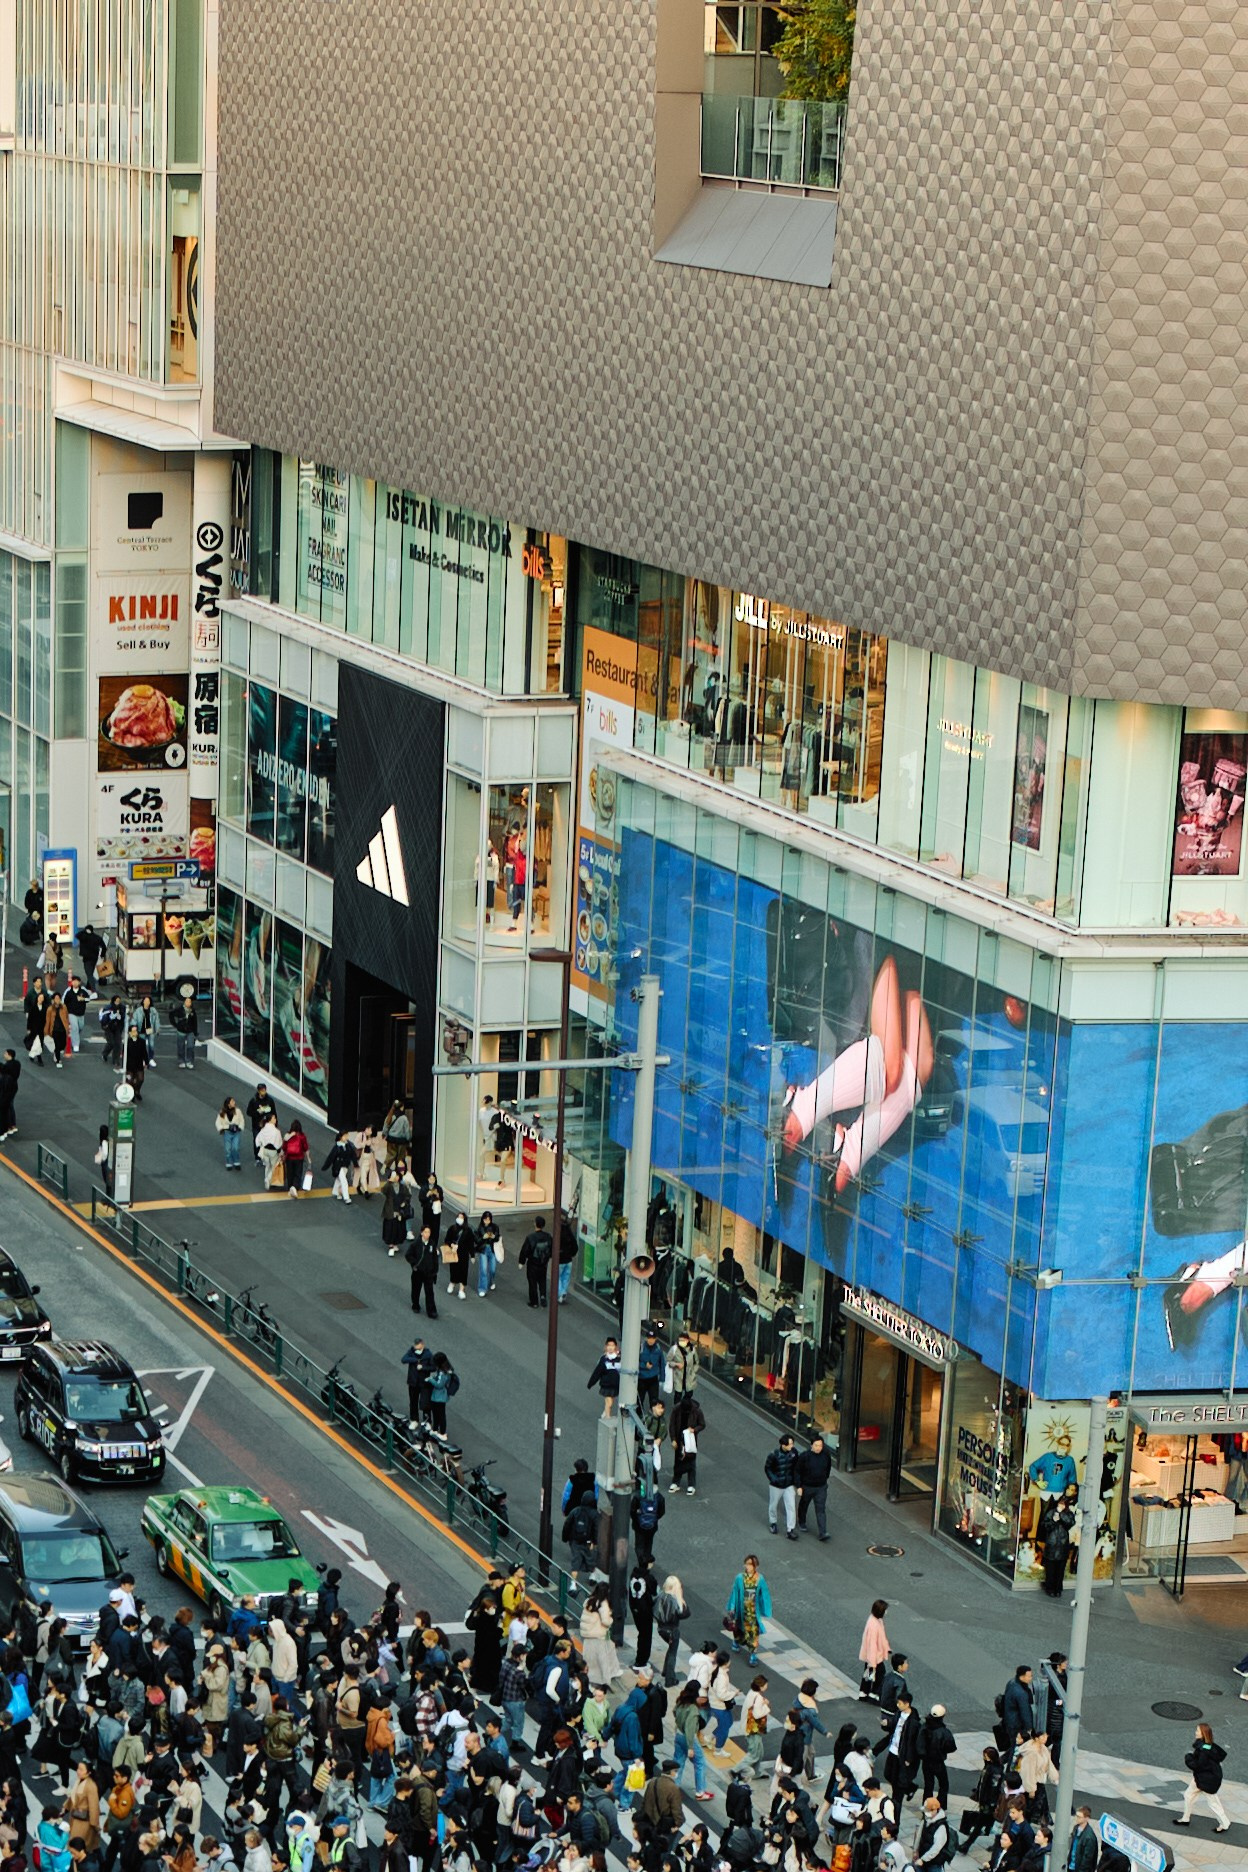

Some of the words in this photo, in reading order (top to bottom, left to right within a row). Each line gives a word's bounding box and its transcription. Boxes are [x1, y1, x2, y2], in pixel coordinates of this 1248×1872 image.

[386, 491, 441, 535] ISETAN
[117, 536, 145, 544] Central
[522, 543, 545, 581] bills
[195, 553, 223, 618] くら
[109, 594, 179, 624] KINJI
[735, 592, 768, 630] JILL
[771, 613, 783, 635] by
[117, 641, 136, 650] Sell
[138, 640, 147, 649] &
[150, 640, 170, 650] Buy
[586, 649, 648, 695] Restaurant
[195, 672, 219, 735] 原宿
[599, 706, 618, 736] bills
[193, 744, 217, 753] KUR
[101, 785, 115, 793] 4F
[120, 787, 163, 811] くら
[120, 813, 163, 824] KURA
[177, 862, 186, 877] P
[499, 1109, 528, 1136] TOKYU
[909, 1325, 944, 1360] TOKYO
[1149, 1406, 1185, 1422] The
